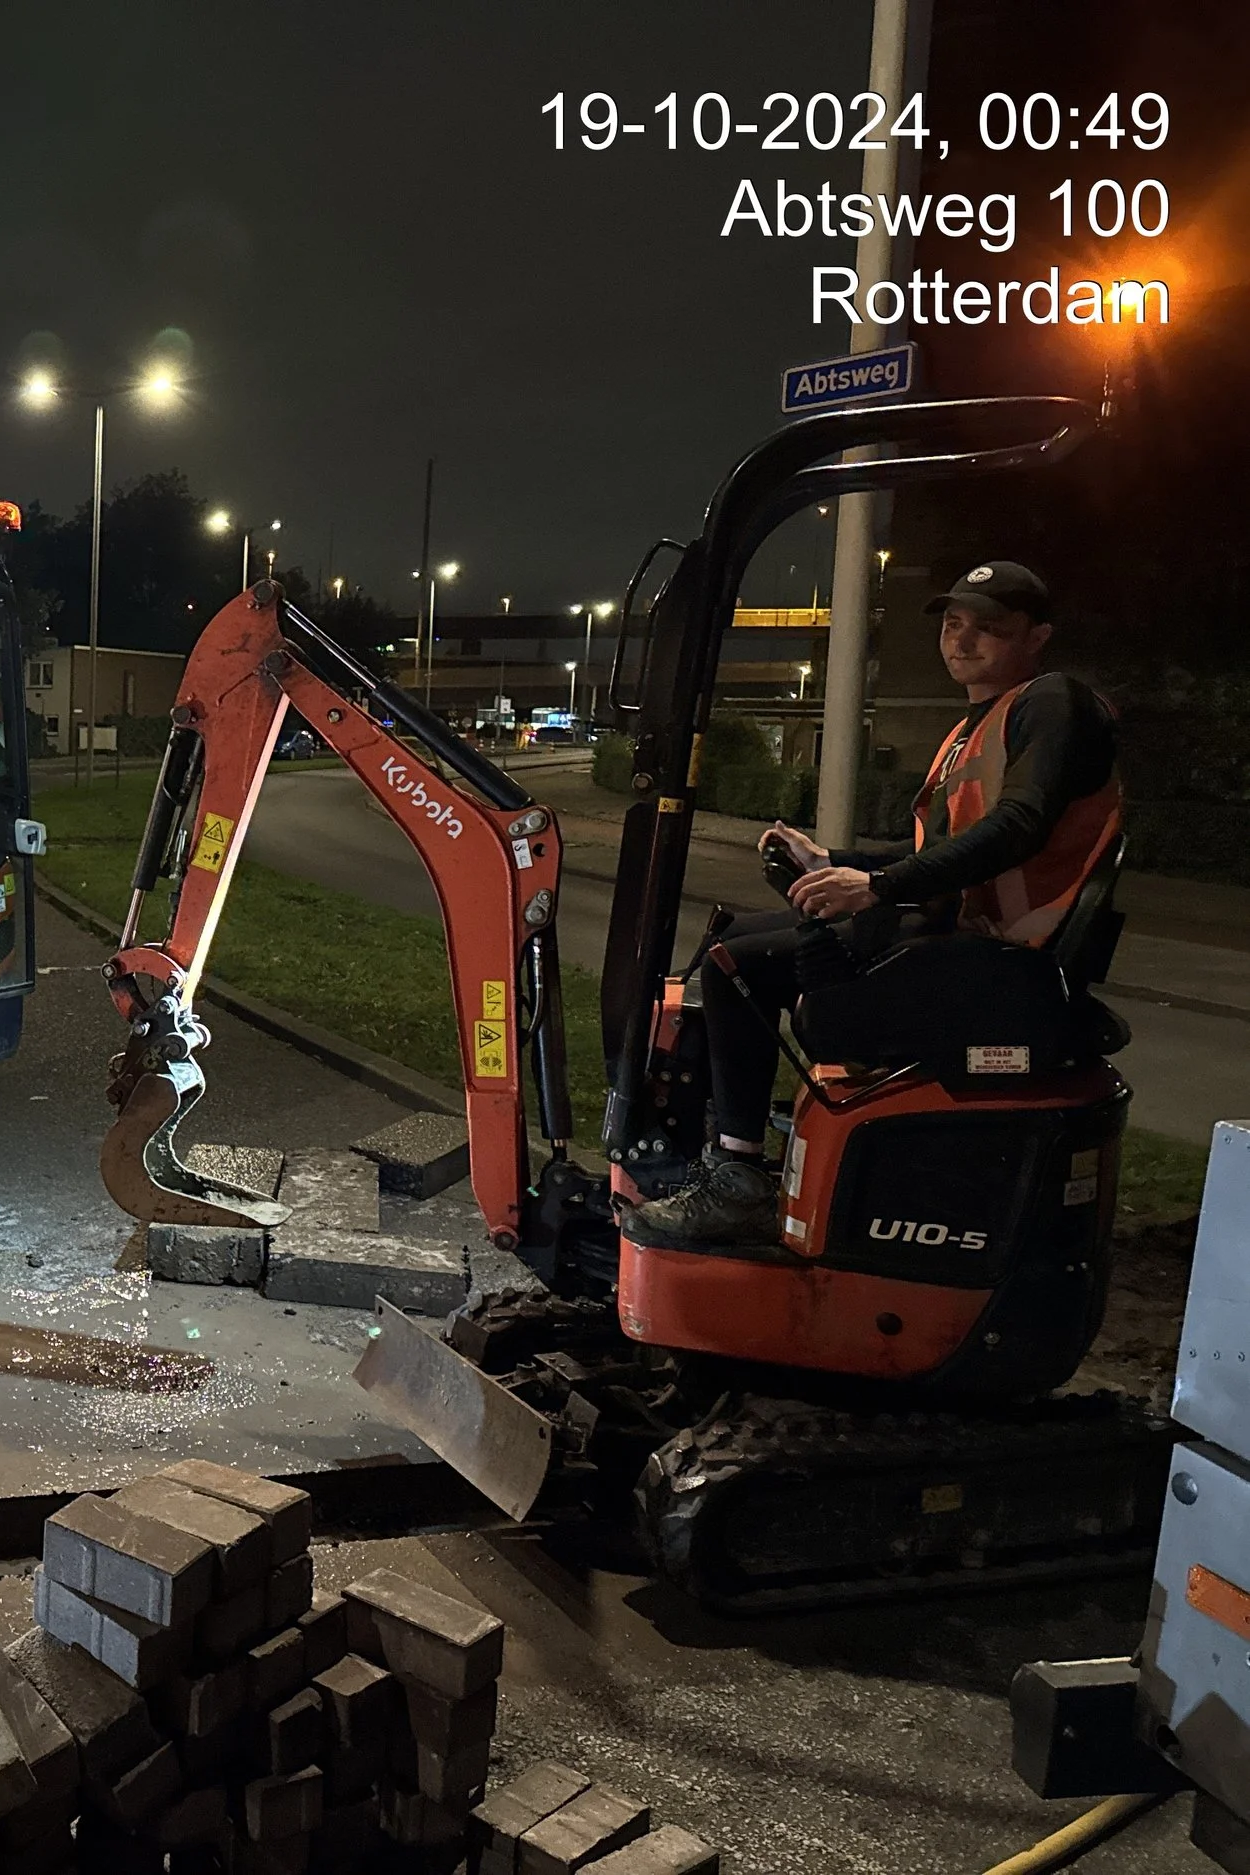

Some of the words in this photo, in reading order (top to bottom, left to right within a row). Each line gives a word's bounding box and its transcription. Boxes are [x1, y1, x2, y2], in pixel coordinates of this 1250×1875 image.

[794, 360, 900, 399] Abtsweg
[381, 756, 464, 840] Kubota
[869, 1218, 988, 1250] U10-5
